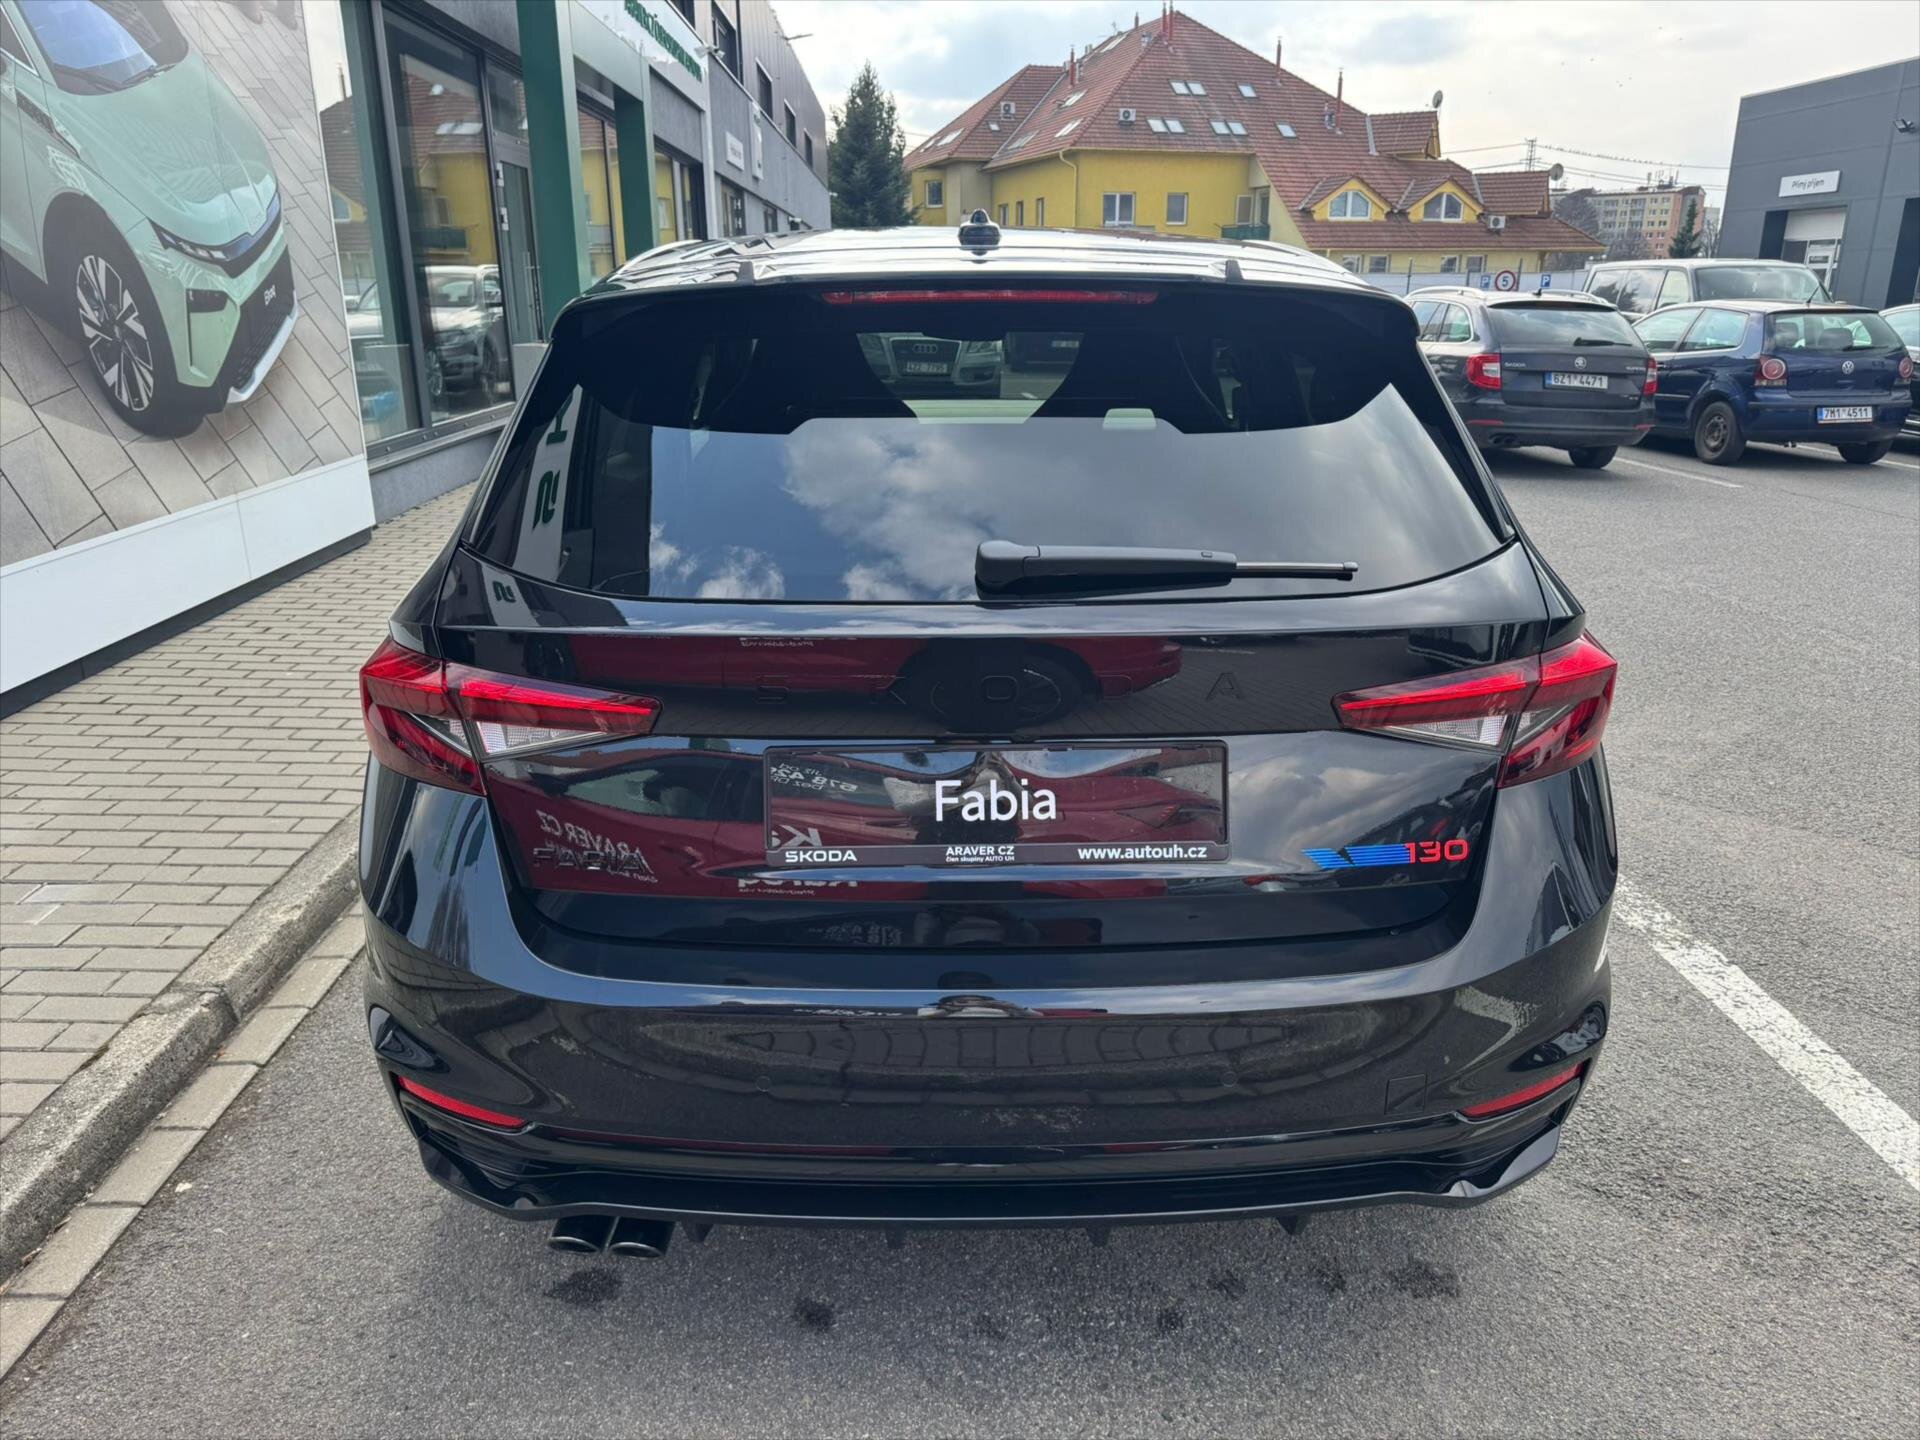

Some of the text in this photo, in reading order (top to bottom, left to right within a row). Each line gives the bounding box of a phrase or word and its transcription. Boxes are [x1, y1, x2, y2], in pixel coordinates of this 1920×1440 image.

[1502, 276, 1509, 287] 5
[1579, 375, 1603, 387] 4471
[1847, 407, 1868, 418] 4511
[935, 778, 1057, 822] Fabia
[945, 845, 1015, 856] ARAVER CZ
[1077, 843, 1208, 860] www.autouh.cz
[1404, 839, 1469, 864] 130
